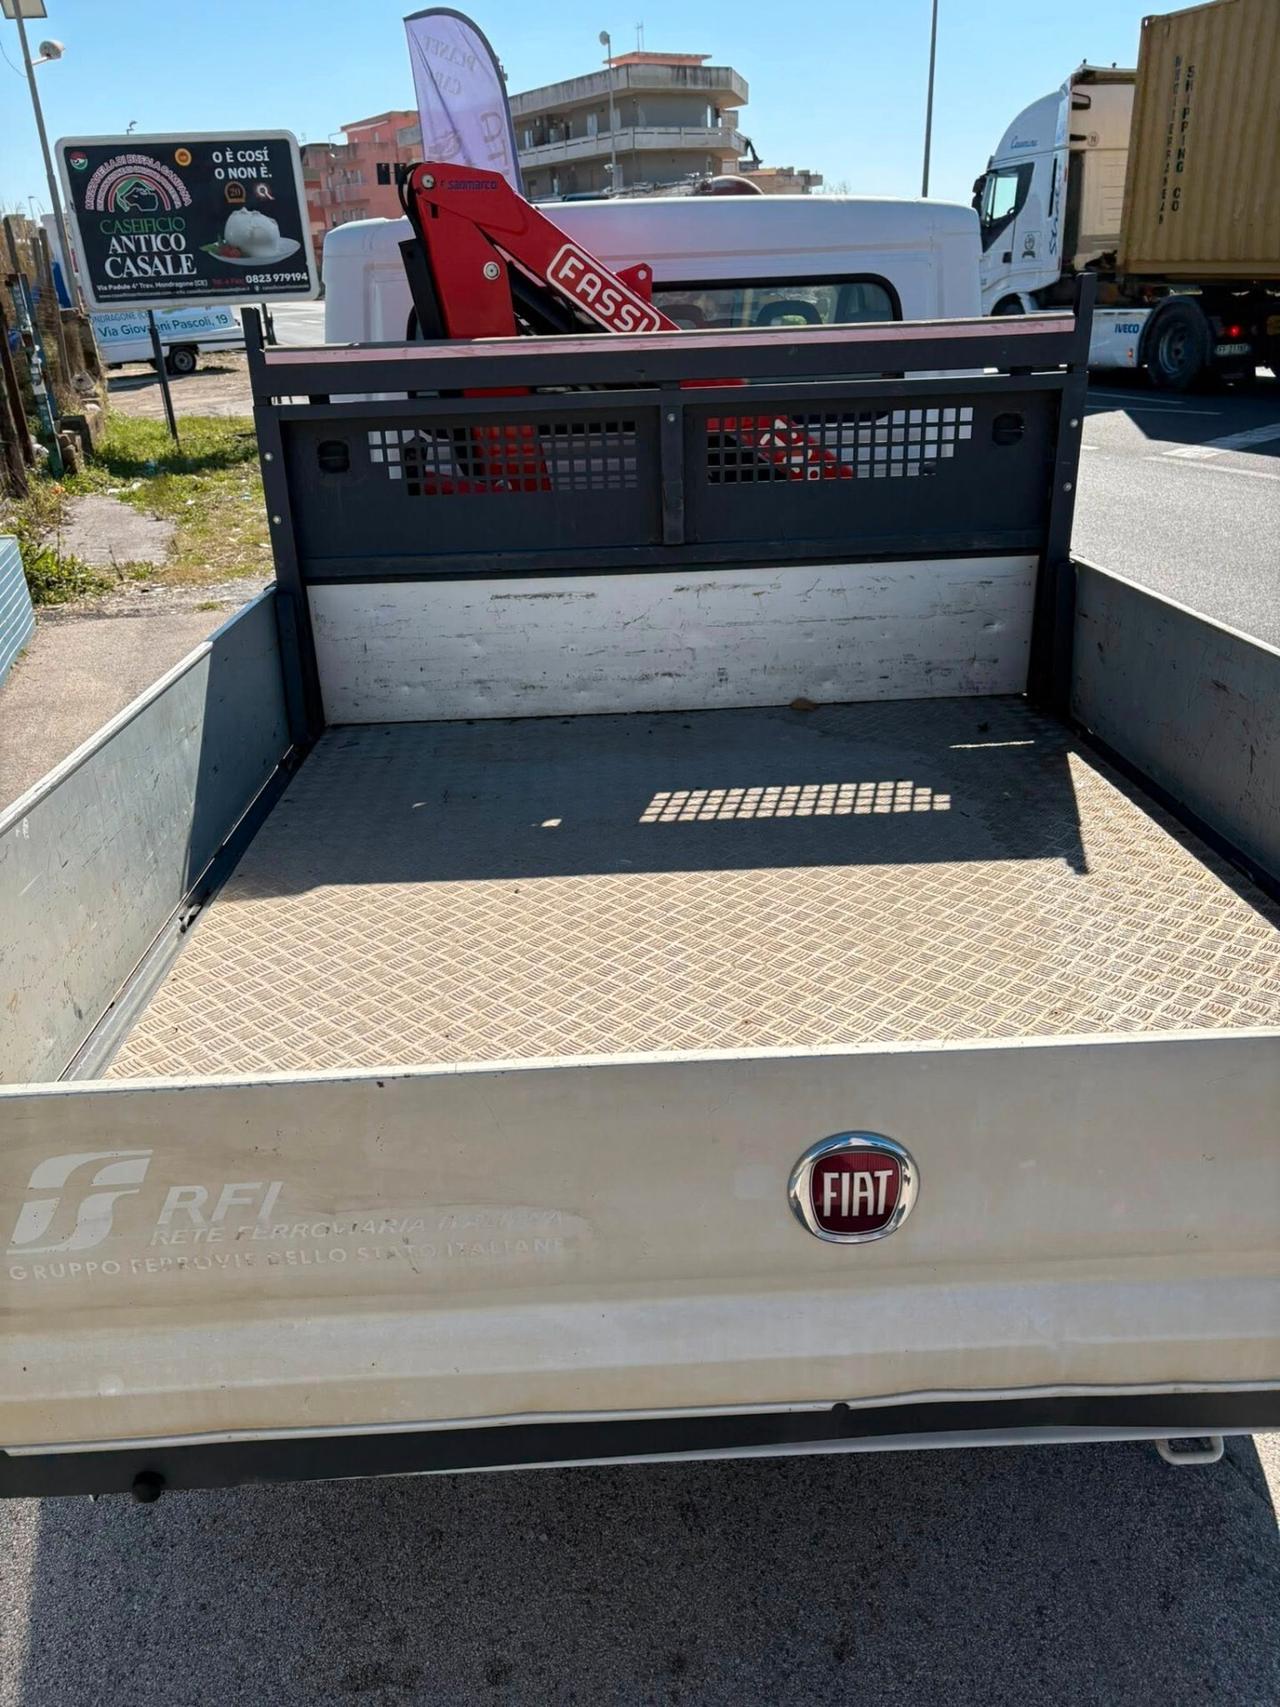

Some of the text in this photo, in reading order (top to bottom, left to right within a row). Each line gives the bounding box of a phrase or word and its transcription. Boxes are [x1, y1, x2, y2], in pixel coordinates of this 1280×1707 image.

[1176, 65, 1196, 174] SHIPPING
[212, 146, 270, 164] O È COSÍ
[214, 168, 225, 180] O
[228, 167, 257, 180] NON
[100, 217, 186, 235] CASEIFICIO
[108, 232, 187, 254] ANTICO
[104, 254, 197, 279] CASALE
[245, 274, 271, 284] 0823
[273, 272, 308, 283] 979194
[558, 256, 649, 332] FASSI
[98, 326, 118, 337] Via
[172, 315, 215, 330] Pascoli,
[216, 314, 229, 325] 19
[1114, 323, 1140, 334] IVECO
[157, 1180, 286, 1226] RFI
[823, 1169, 893, 1217] FIAT
[150, 1225, 225, 1247] RETE
[9, 1259, 121, 1281] GRUPPO
